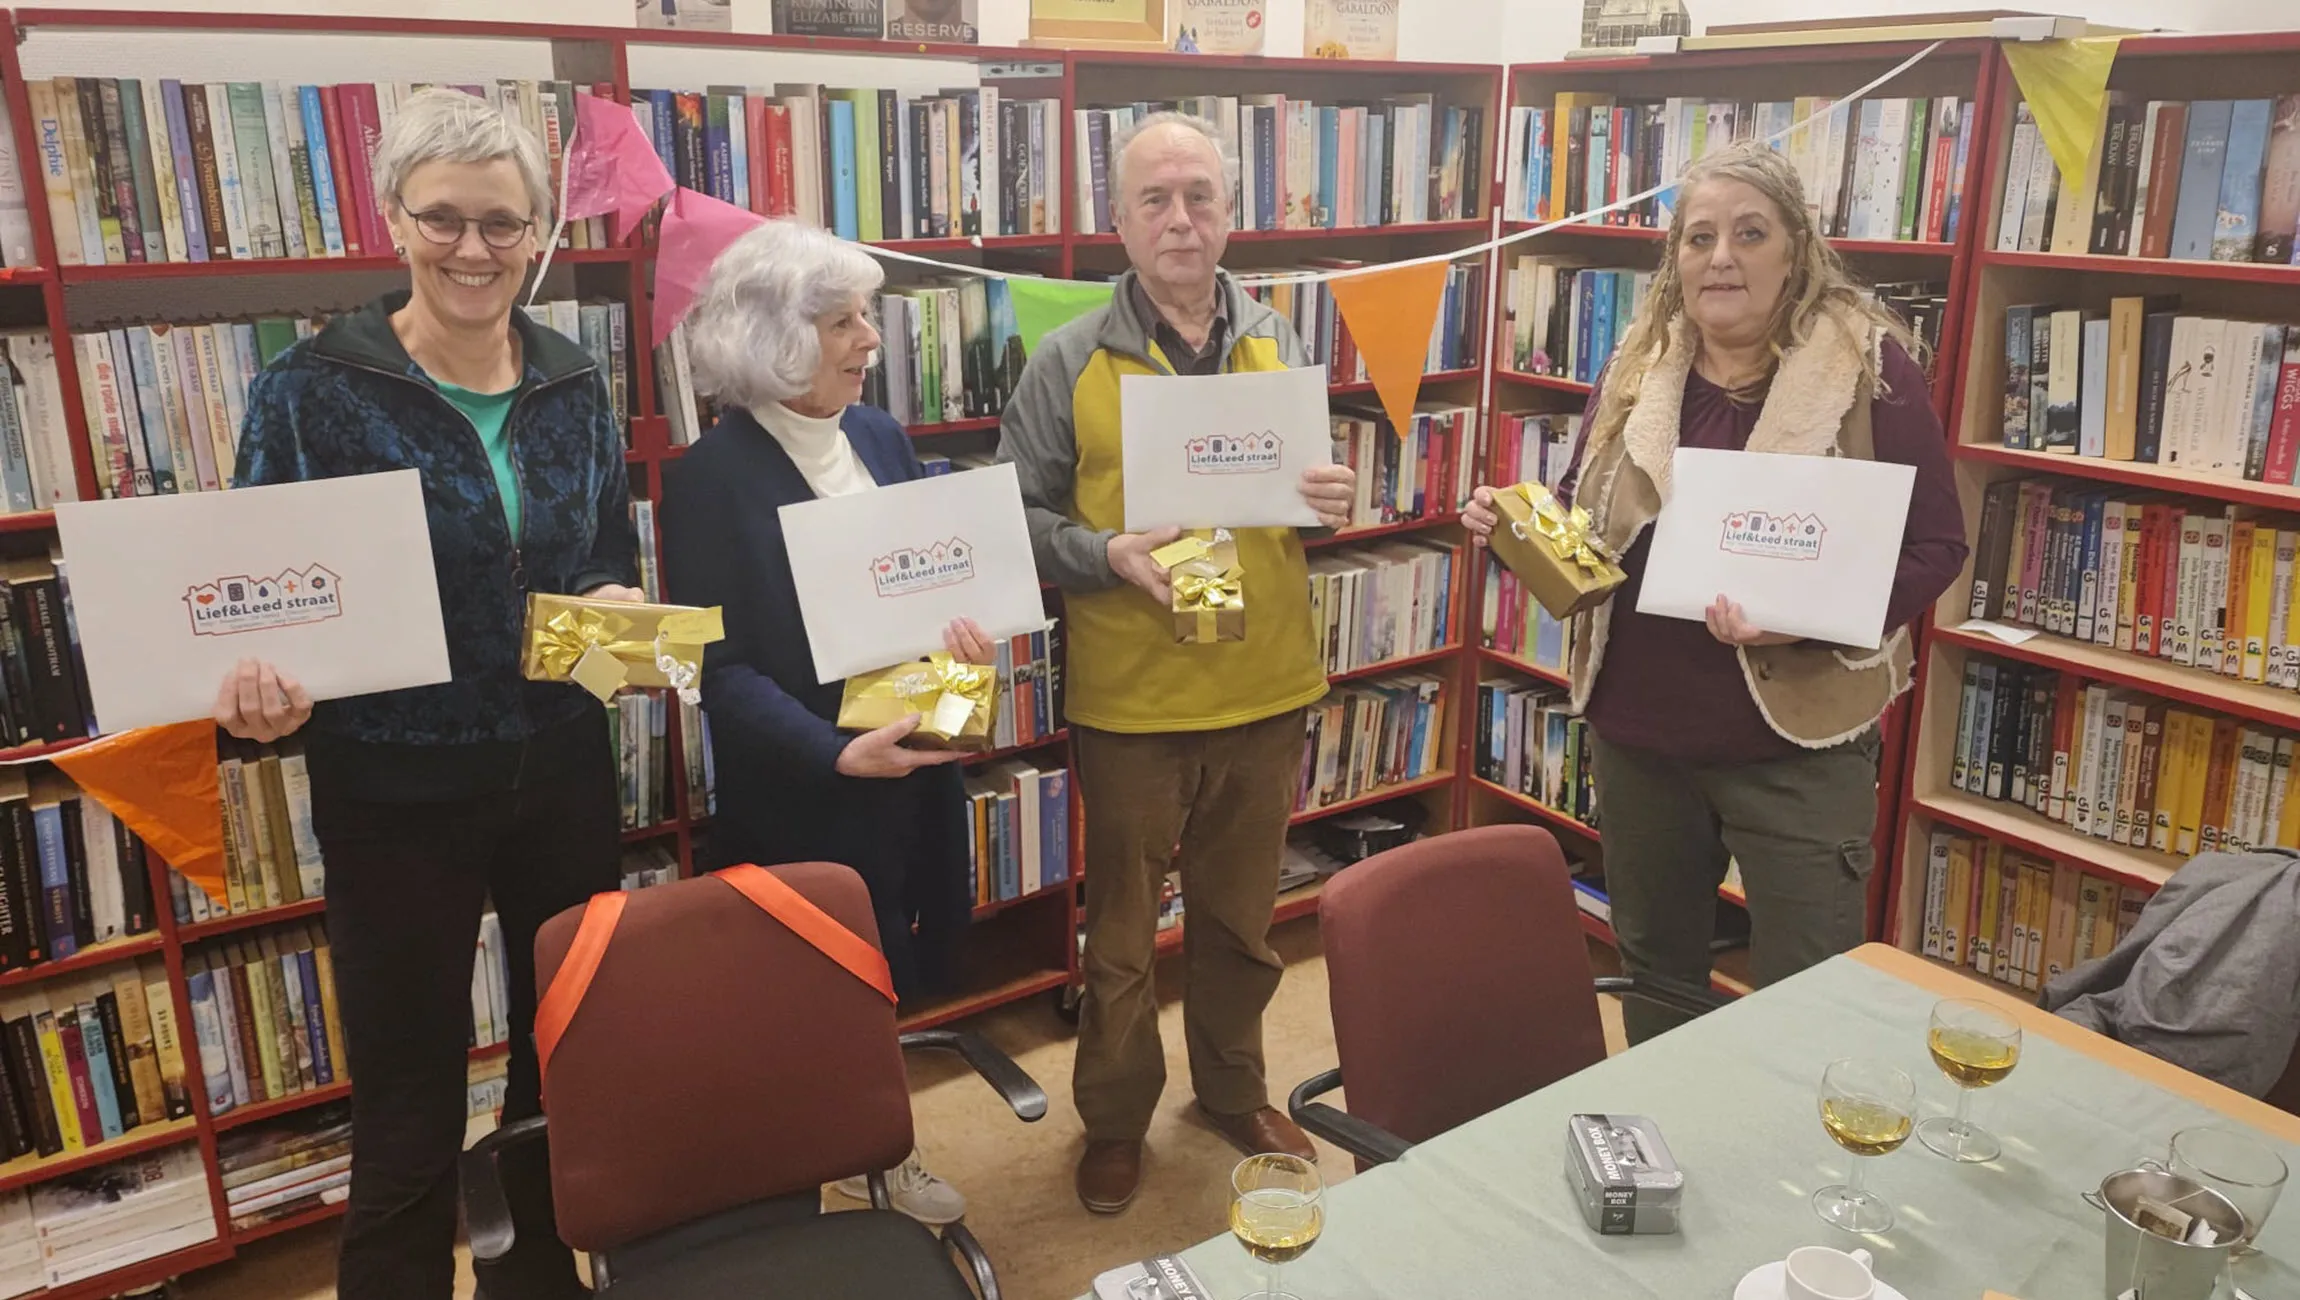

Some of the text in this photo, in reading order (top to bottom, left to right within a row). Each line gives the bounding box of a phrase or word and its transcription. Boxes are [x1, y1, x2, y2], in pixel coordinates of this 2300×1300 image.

[790, 0, 877, 10] KONINGIN
[792, 10, 878, 25] ELIZABETH II
[1337, 2, 1394, 16] GABALDON
[891, 23, 974, 39] RESERVE
[40, 119, 63, 177] Delphie
[2106, 118, 2125, 166] TERLOUW
[2123, 117, 2144, 167] TERLOUW
[2280, 367, 2298, 410] WIGGS
[2189, 386, 2207, 452] WEISBERGER
[1191, 452, 1277, 464] Lief&Leed straat
[1725, 530, 1781, 545] Lief&Leed
[878, 565, 936, 586] Lief&Leed
[937, 559, 970, 574] straat
[195, 593, 335, 621] Lief&Leed straat
[34, 587, 62, 677] MICHAEL ROBOTHAM
[1588, 1127, 1621, 1180] MONEY BOX
[1605, 1191, 1633, 1199] MONEY
[1157, 1258, 1191, 1296] MONEY
